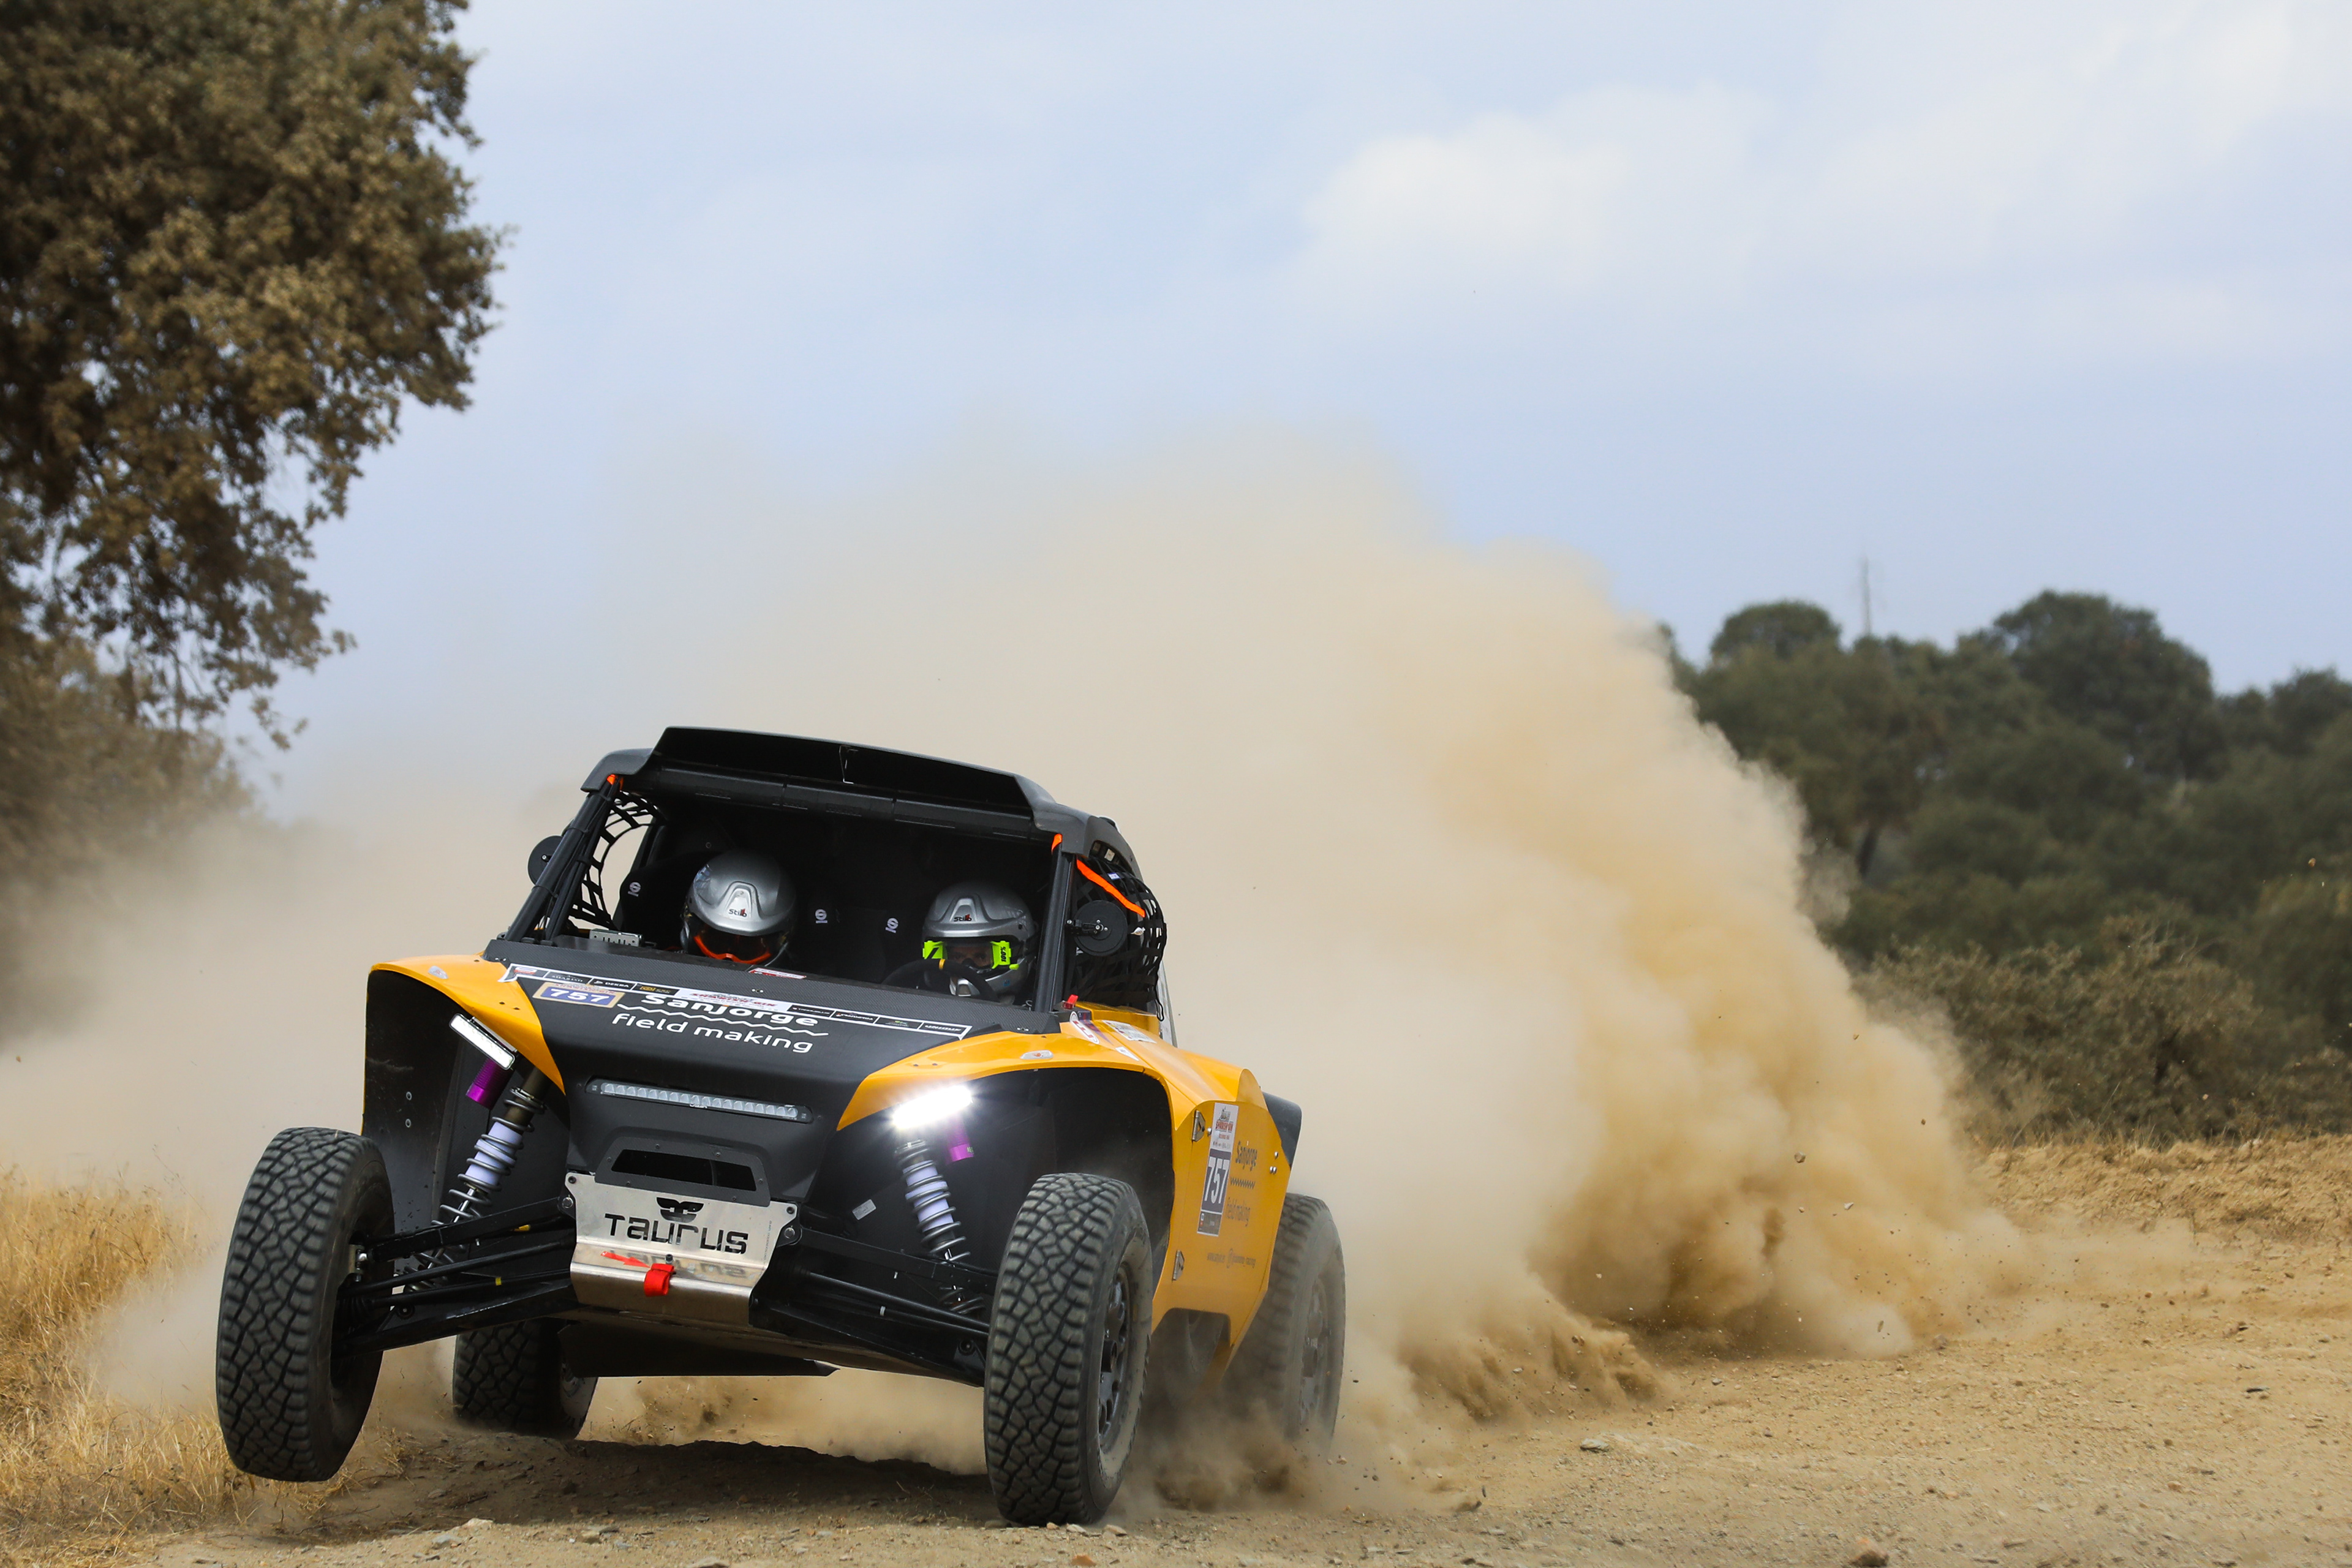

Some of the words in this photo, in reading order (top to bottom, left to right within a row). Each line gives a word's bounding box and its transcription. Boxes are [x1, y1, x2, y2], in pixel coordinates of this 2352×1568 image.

[728, 908, 747, 918] Stilo
[549, 988, 610, 1003] 757
[641, 993, 818, 1026] Sanjorge
[612, 1012, 688, 1033] field
[696, 1027, 813, 1053] making
[1235, 1140, 1257, 1171] Sanjorge
[1204, 1156, 1230, 1205] 757
